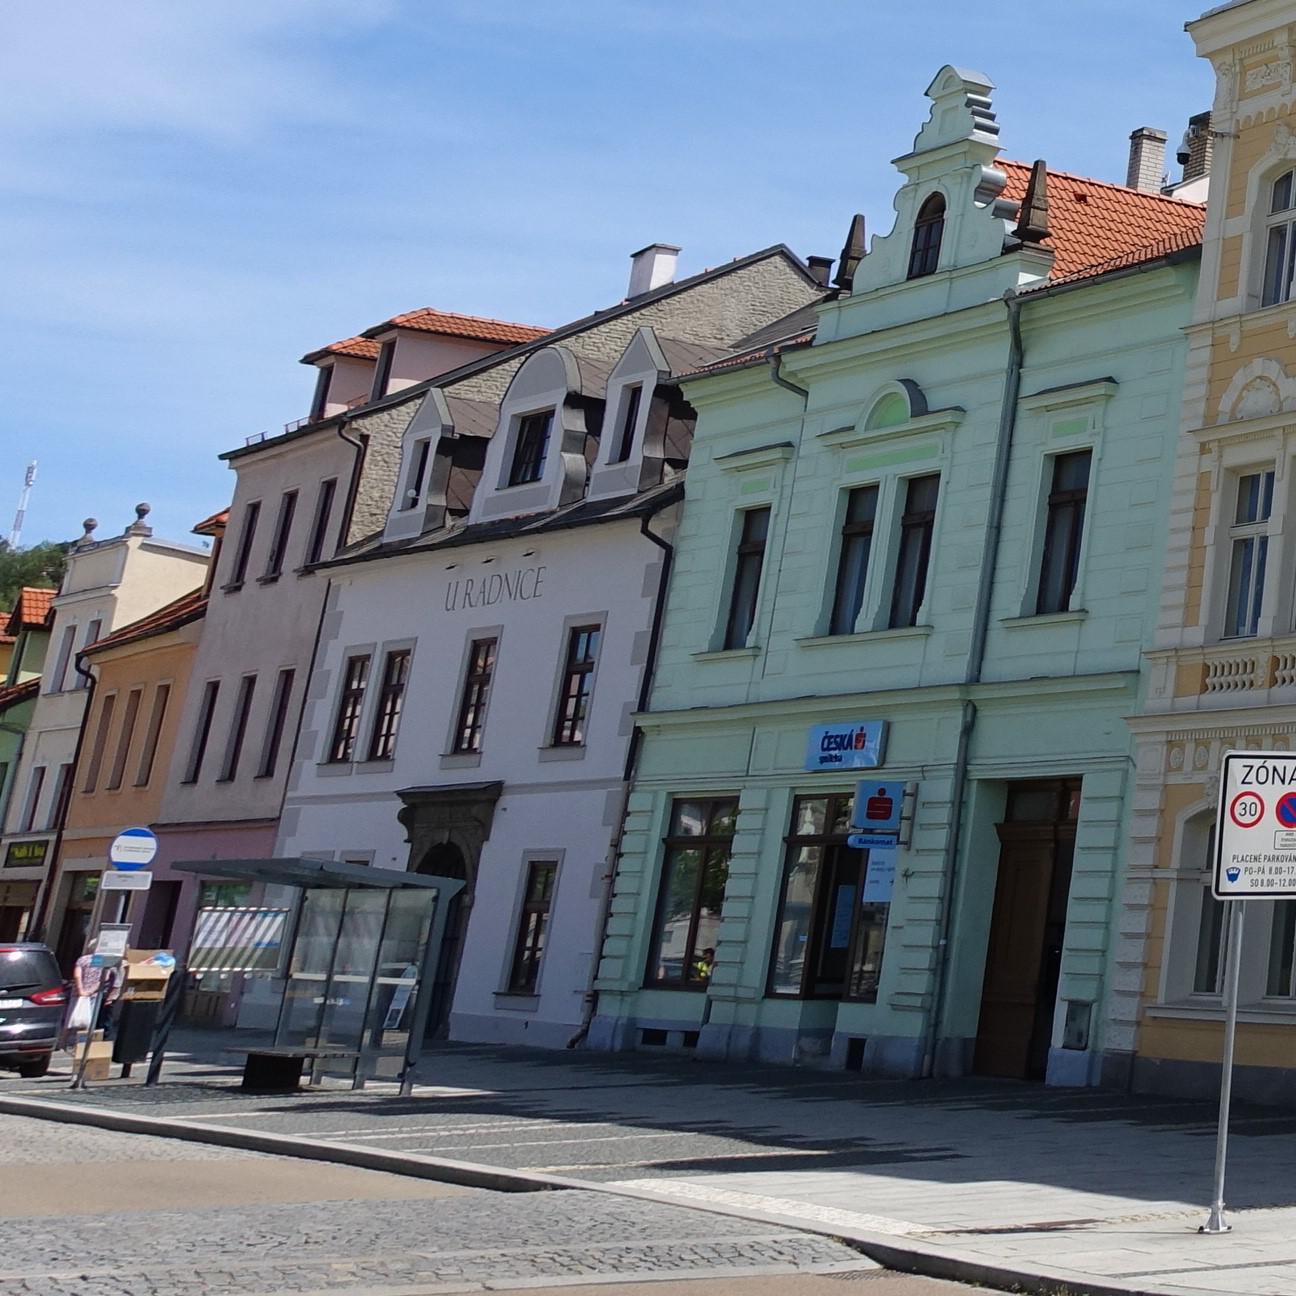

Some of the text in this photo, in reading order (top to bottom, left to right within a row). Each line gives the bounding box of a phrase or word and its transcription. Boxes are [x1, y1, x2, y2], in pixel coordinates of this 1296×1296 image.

[445, 566, 547, 611] U RADNICE
[821, 729, 854, 752] ČESKÁ
[1238, 802, 1258, 817] 30
[858, 837, 893, 846] Bankomat
[1232, 852, 1262, 863] PLACENÉ
[1244, 865, 1266, 875] PO-PÁ
[1250, 878, 1259, 887] SO
